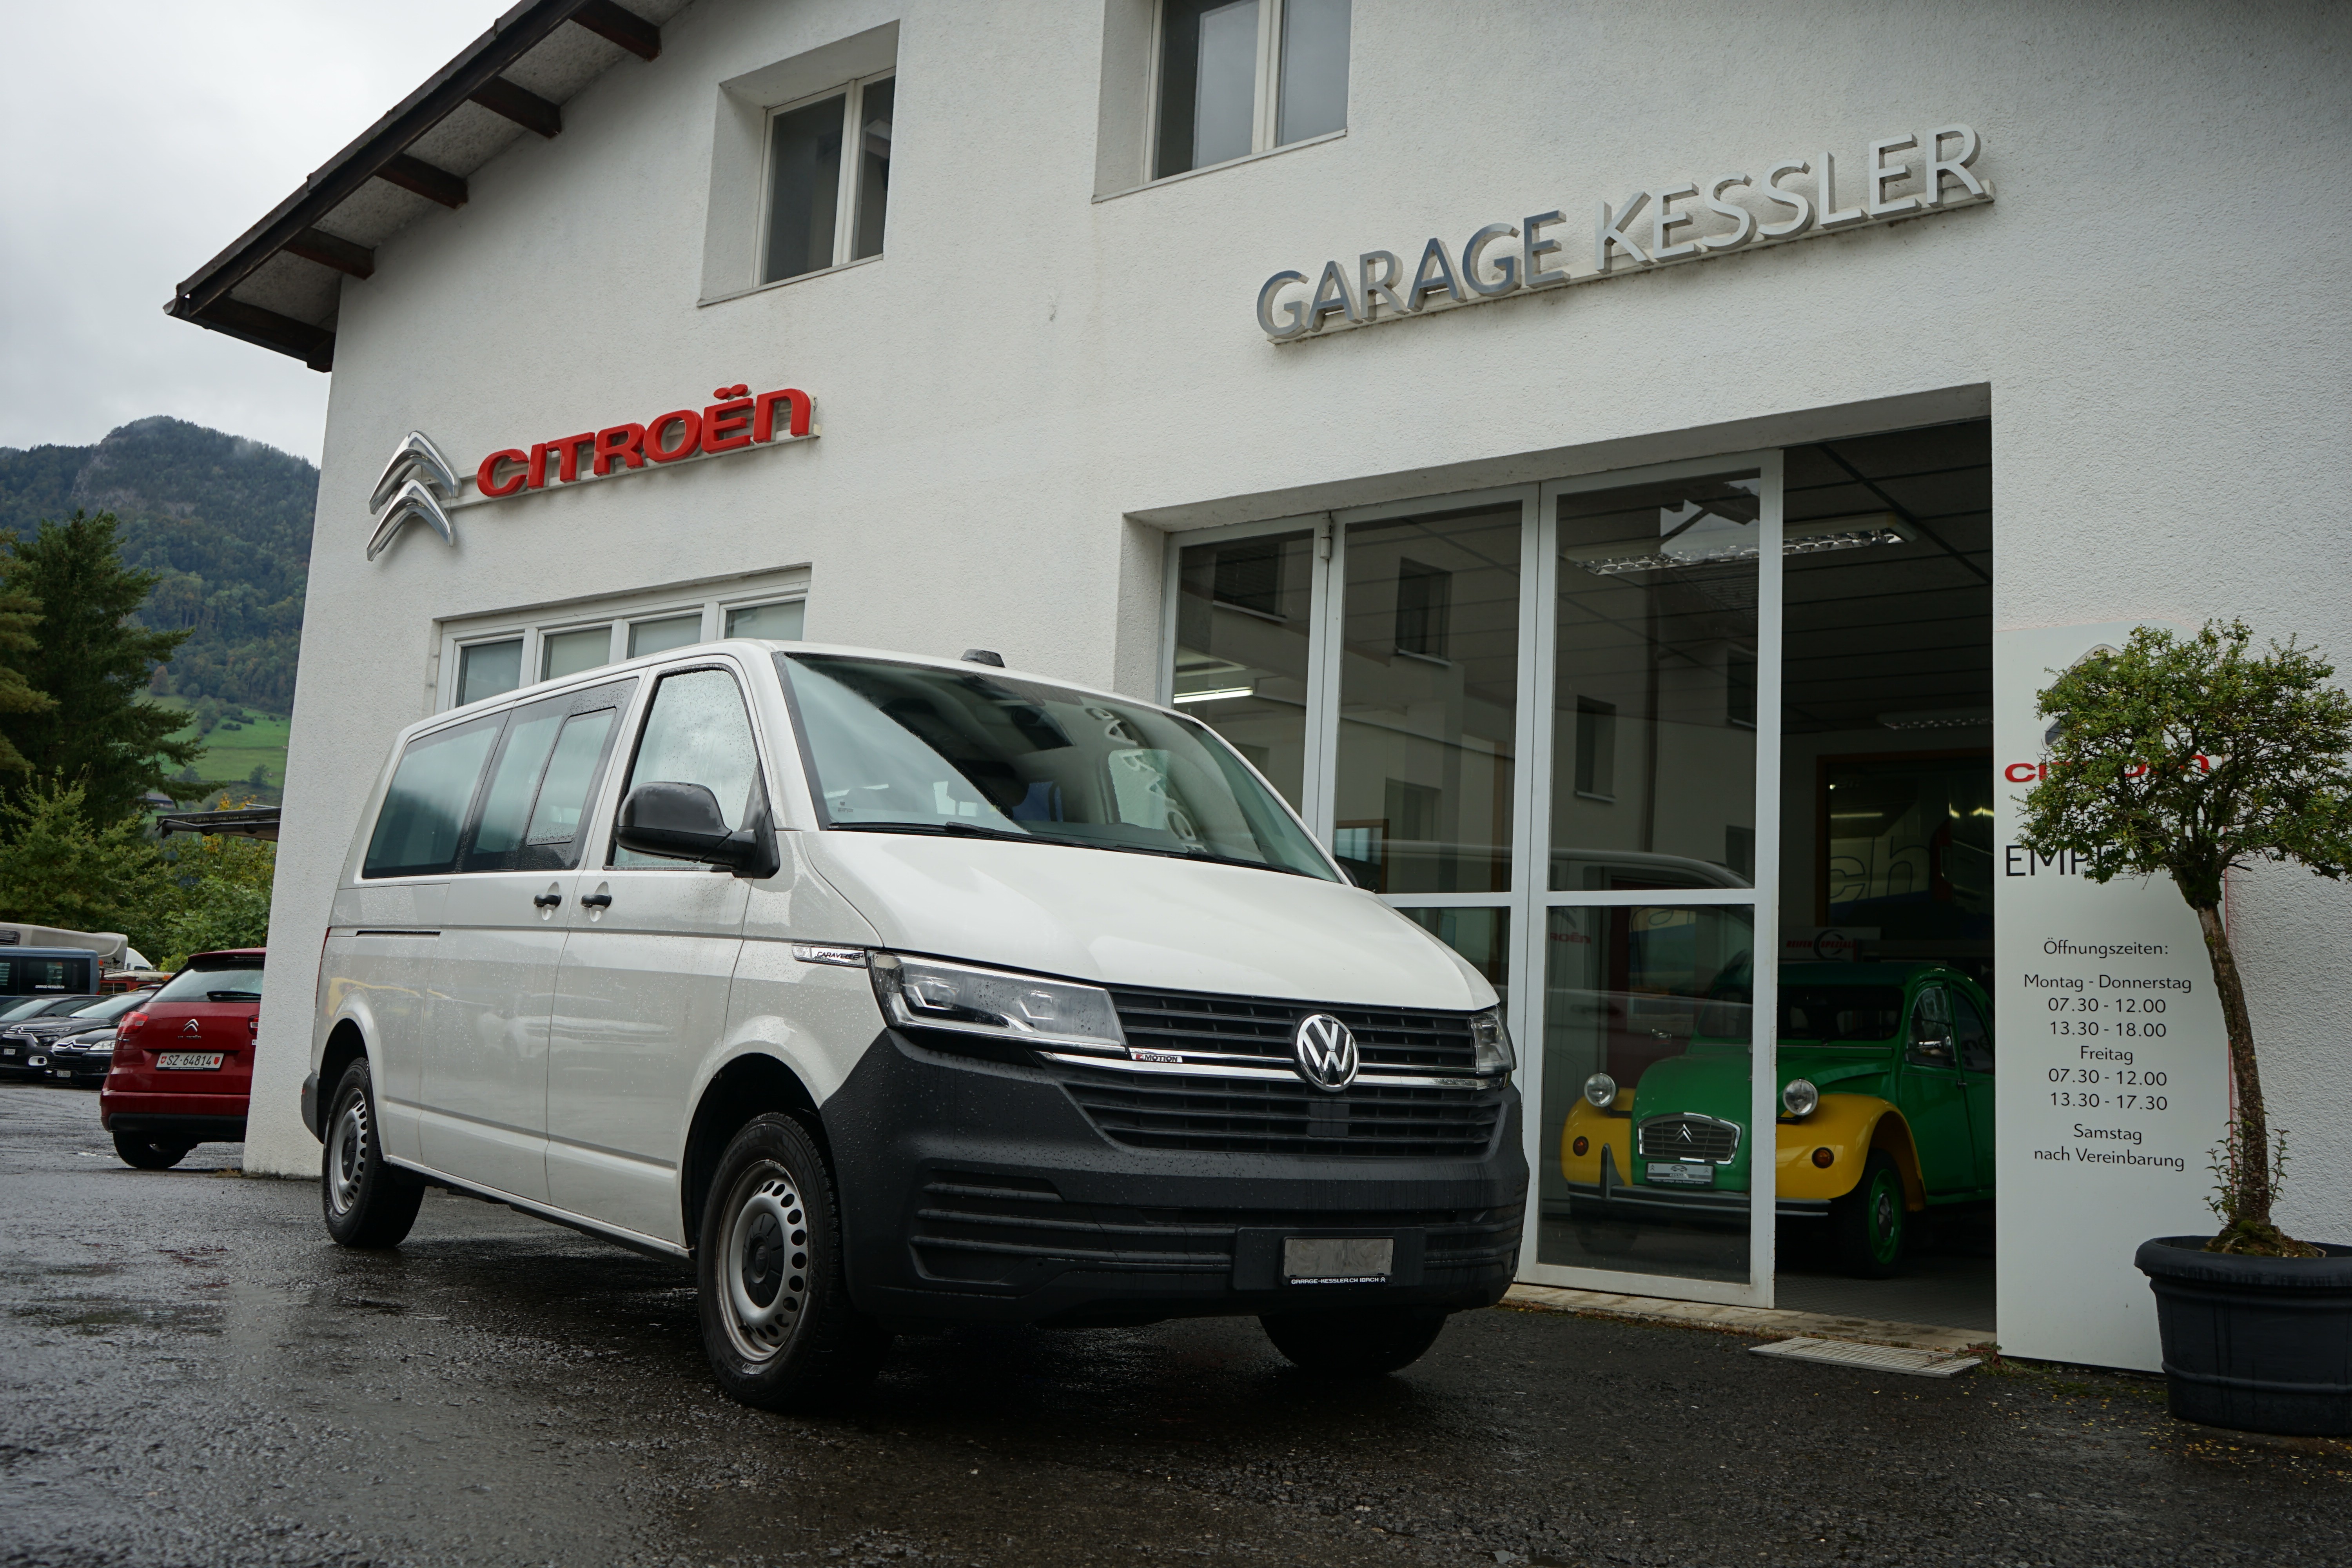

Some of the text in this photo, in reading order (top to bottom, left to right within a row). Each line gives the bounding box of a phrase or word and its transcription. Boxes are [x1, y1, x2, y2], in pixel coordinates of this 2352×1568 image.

[1257, 122, 1985, 339] GARAGE KESSLER
[2044, 937, 2168, 958] Öffnungszeiten:
[2024, 974, 2083, 993] Montag
[2099, 975, 2191, 993] Donnerstag
[2048, 997, 2099, 1012] 07.30
[2116, 998, 2166, 1013] 12.00
[2050, 1021, 2099, 1036] 13.30
[2116, 1022, 2167, 1038] 18.00
[2081, 1045, 2133, 1065] Freitag
[2049, 1068, 2099, 1083] 07.30
[2116, 1071, 2167, 1086] 12.00
[2051, 1092, 2100, 1107] 13.30
[2117, 1094, 2167, 1111] 17.30
[2073, 1123, 2142, 1145] Samstag
[2034, 1145, 2184, 1172] nach Vereinbarung
